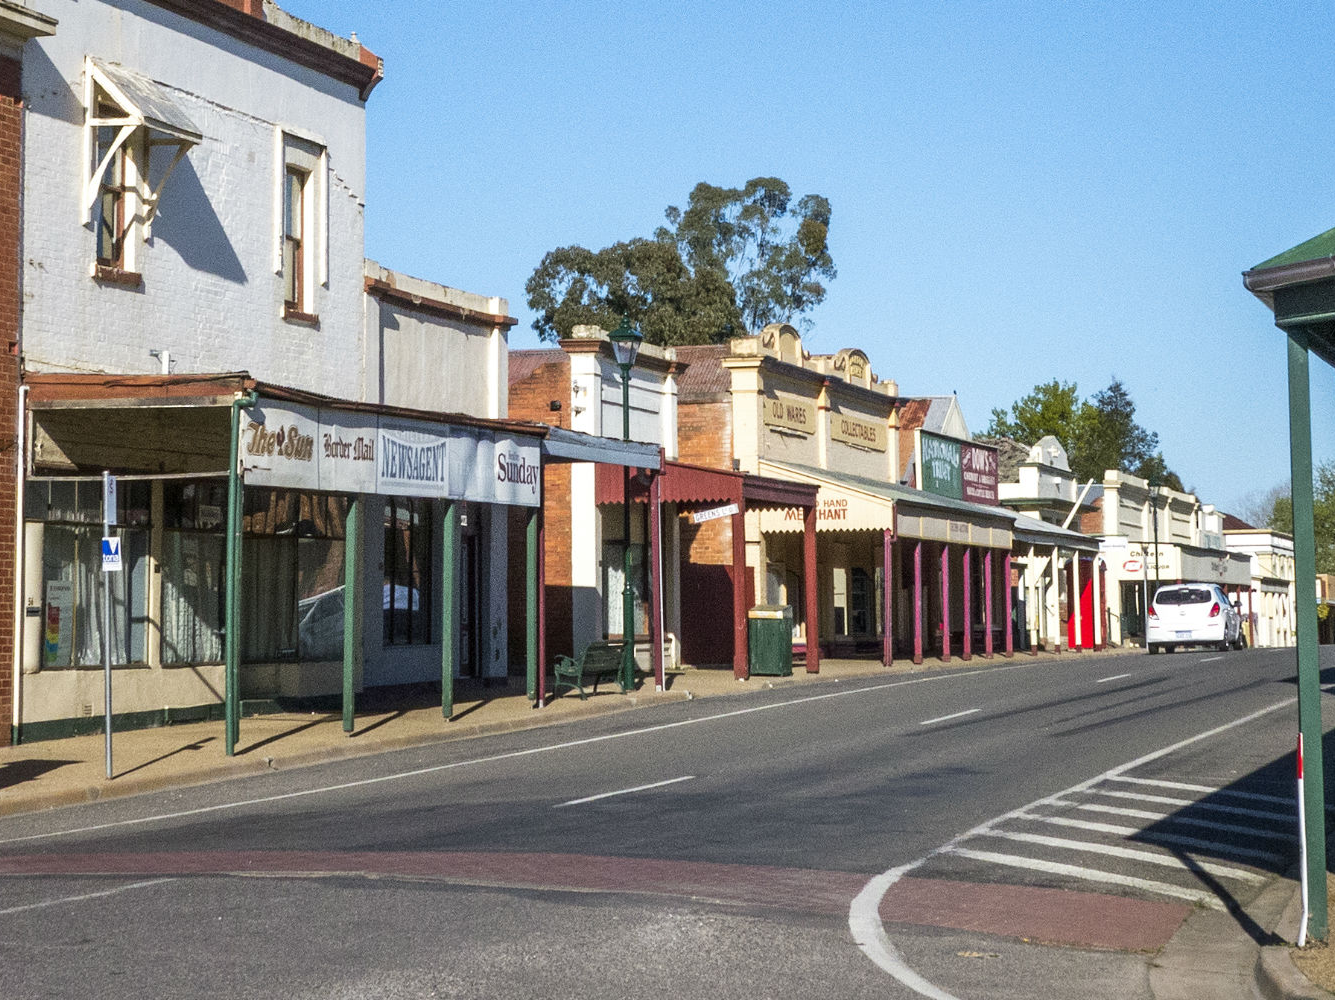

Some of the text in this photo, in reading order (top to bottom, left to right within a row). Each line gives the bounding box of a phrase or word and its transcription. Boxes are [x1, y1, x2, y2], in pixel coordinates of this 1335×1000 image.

[773, 402, 807, 425] OLD WARES
[247, 421, 315, 462] The Sun
[841, 420, 877, 443] COLLECTABLES
[323, 432, 352, 461] Border
[353, 436, 375, 462] Mail
[381, 434, 447, 482] NEWSAGENT
[497, 452, 540, 494] Sunday
[784, 509, 848, 521] MEHANT
[823, 499, 848, 508] HAND
